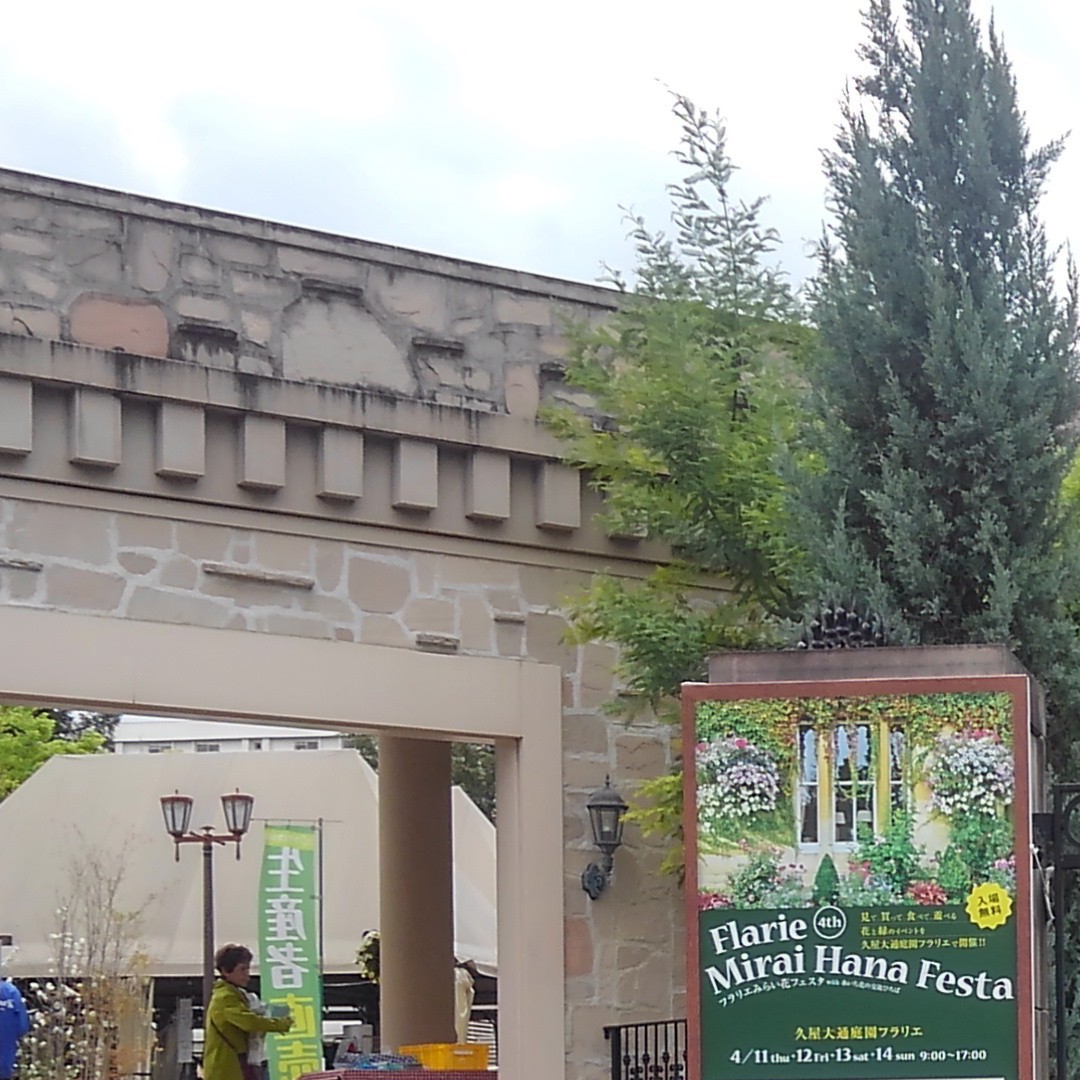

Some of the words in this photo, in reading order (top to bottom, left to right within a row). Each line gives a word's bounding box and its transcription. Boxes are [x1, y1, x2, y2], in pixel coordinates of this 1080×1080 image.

[978, 893, 1000, 907] 入場
[979, 905, 1002, 919] 無料
[709, 913, 808, 955] Flarie
[817, 915, 842, 929] 4th
[704, 944, 806, 995] Mirai
[814, 945, 909, 985] Hana
[916, 958, 1015, 1001] Festa
[794, 1025, 924, 1041] 久屋大通庭園フラリエ
